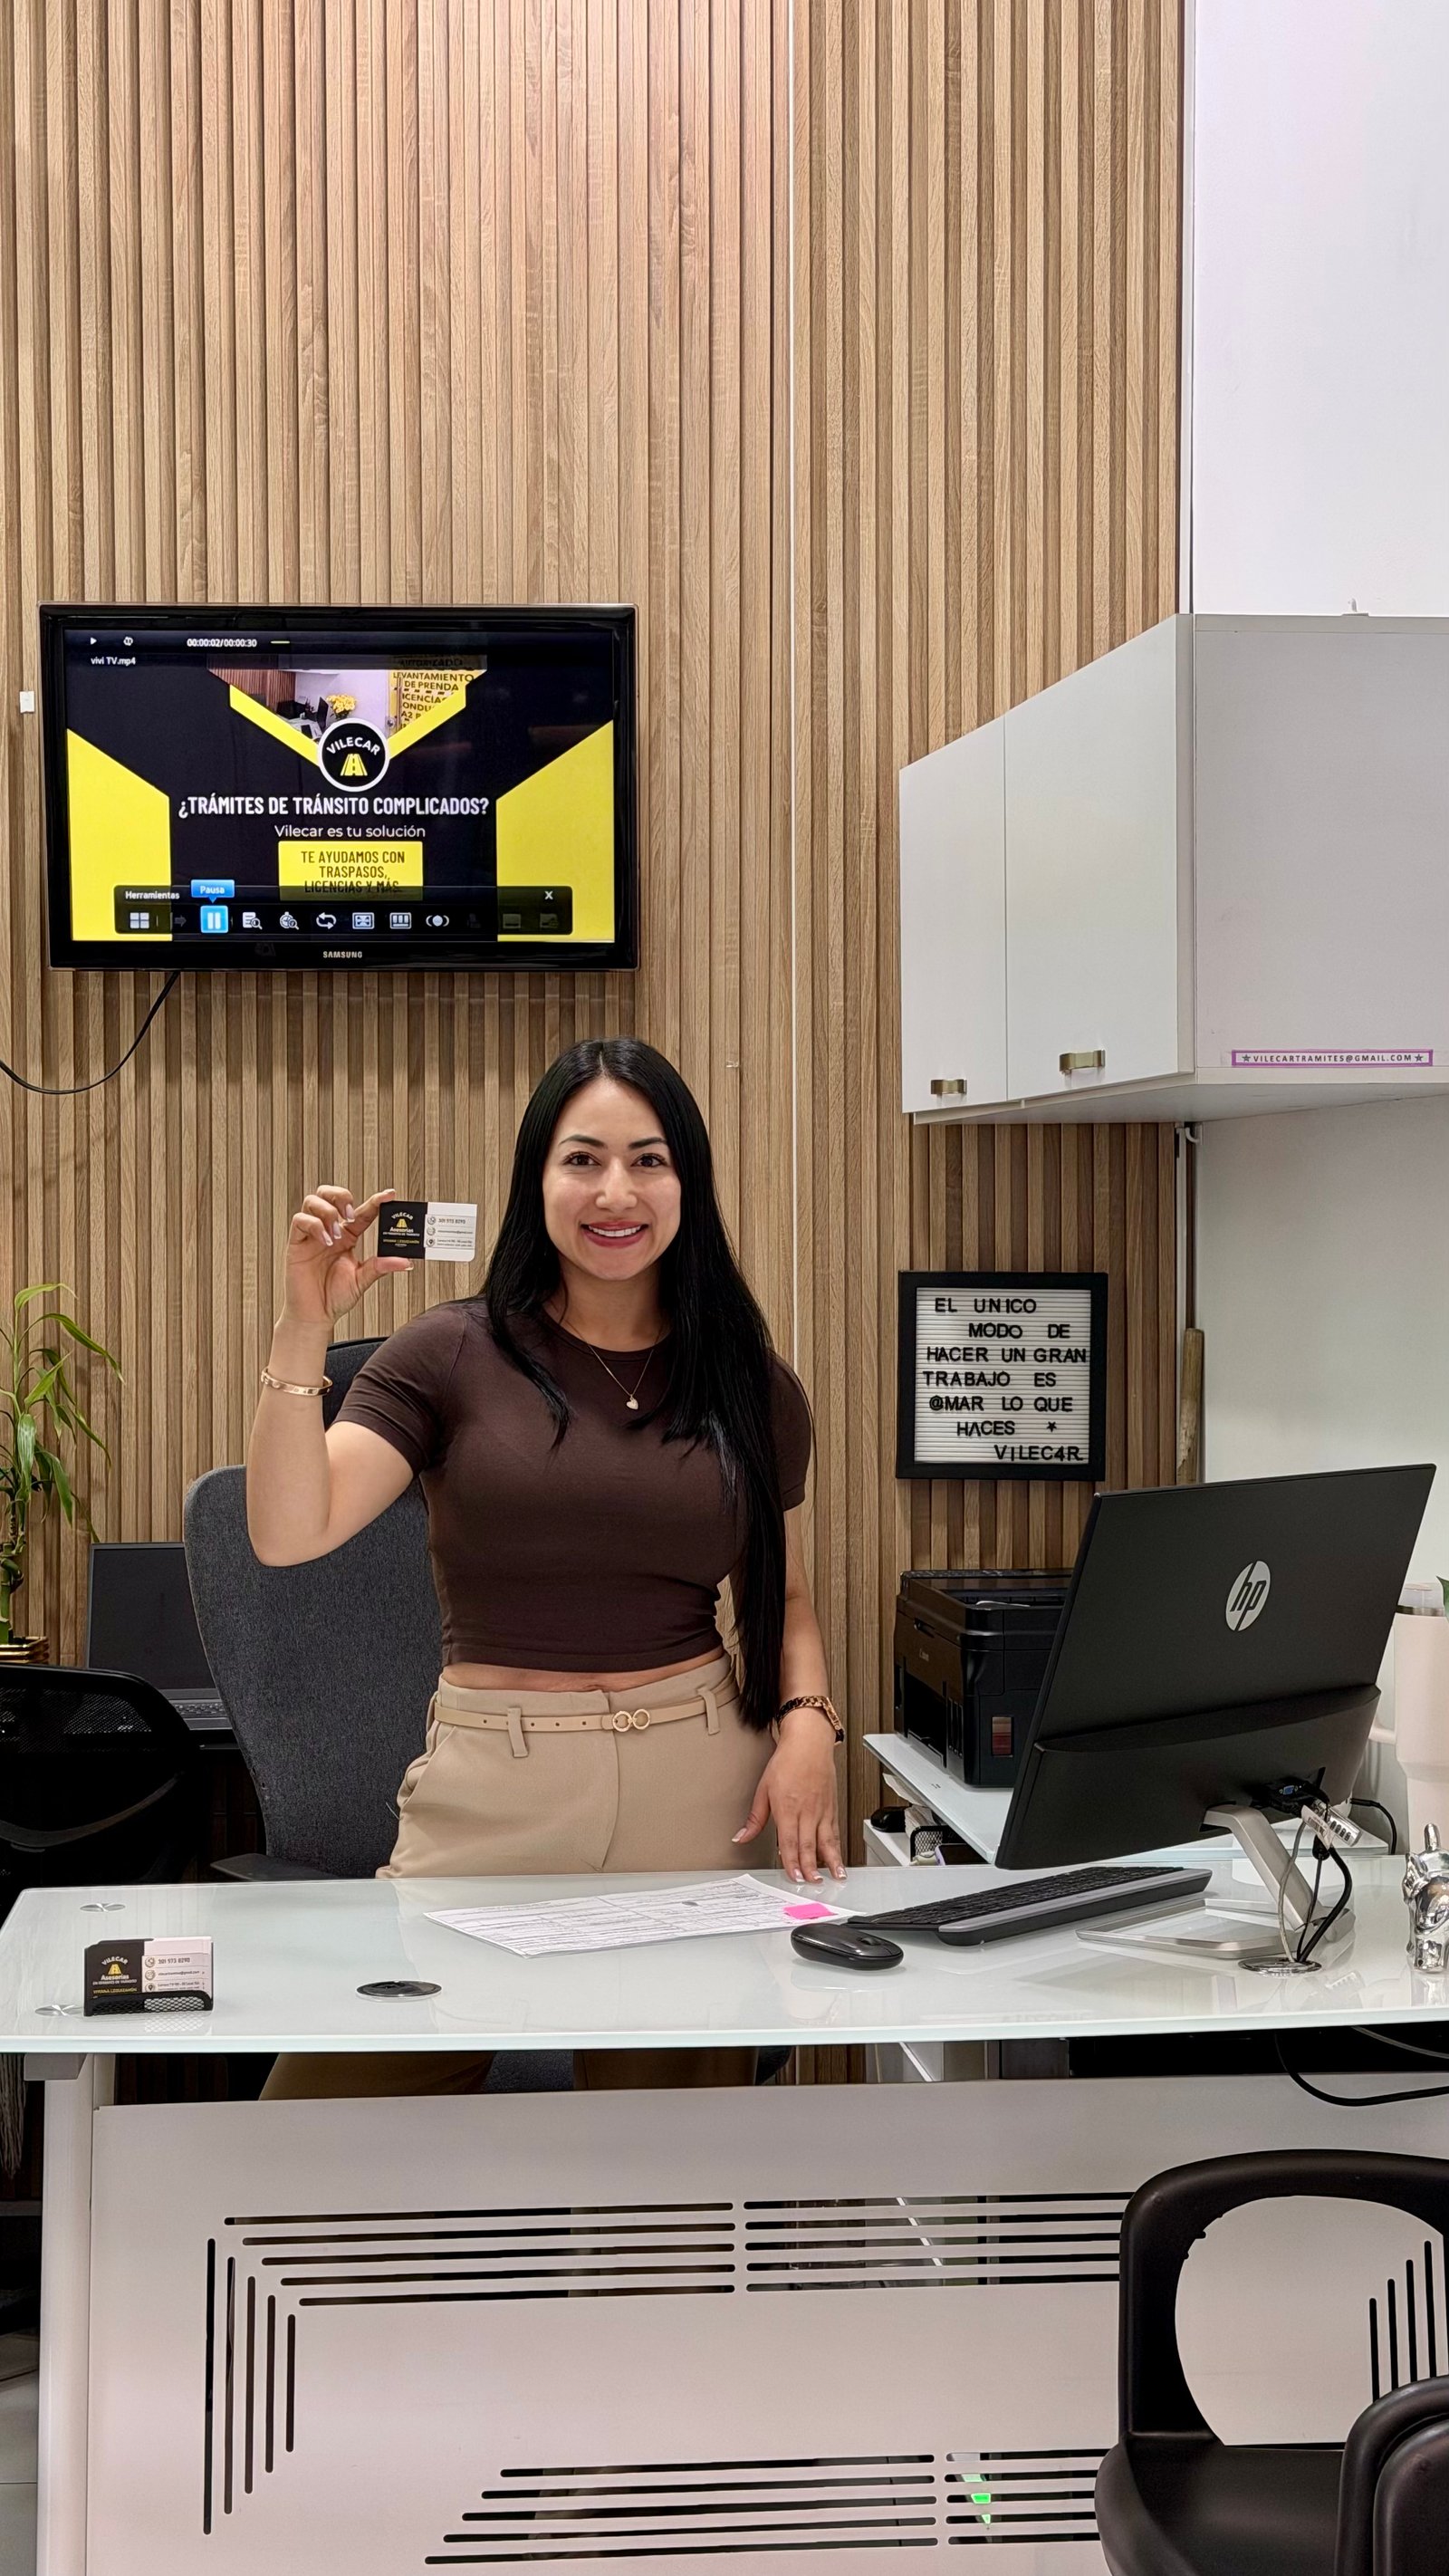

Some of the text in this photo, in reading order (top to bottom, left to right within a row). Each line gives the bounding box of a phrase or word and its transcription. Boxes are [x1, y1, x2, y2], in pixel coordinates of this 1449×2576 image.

[187, 639, 257, 648] 00:00:02/00:00:30
[91, 657, 136, 667] vivi TV.mp4
[393, 672, 475, 683] LEVANTAMIENTO
[404, 680, 459, 691] DE PRENDA
[326, 736, 381, 756] VILECAR
[178, 793, 489, 818] ¿TRÁMITES DE TRÁNSITO COMPLICADOS?
[274, 824, 426, 838] Vilecar es tu solución
[301, 851, 405, 863] TE AYUDAMOS CON
[320, 866, 388, 879] TRASPASOS,
[199, 885, 226, 895] Pausa
[304, 880, 362, 893] LICENCIAS
[366, 880, 373, 893] Y
[125, 890, 180, 899] Herramientas
[1253, 1053, 1412, 1063] VILECARTRAMITES@GMAIL.COM
[935, 1298, 1037, 1313] EL UNICO
[968, 1322, 1070, 1339] MODO DE
[926, 1347, 1087, 1363] HACER UN GRAN
[923, 1370, 1056, 1387] TRABAJO ES
[929, 1395, 1073, 1412] @MAR LO QUE
[956, 1420, 1015, 1437] HACES
[1228, 1561, 1268, 1631] hp
[101, 1956, 128, 1966] VILECAR
